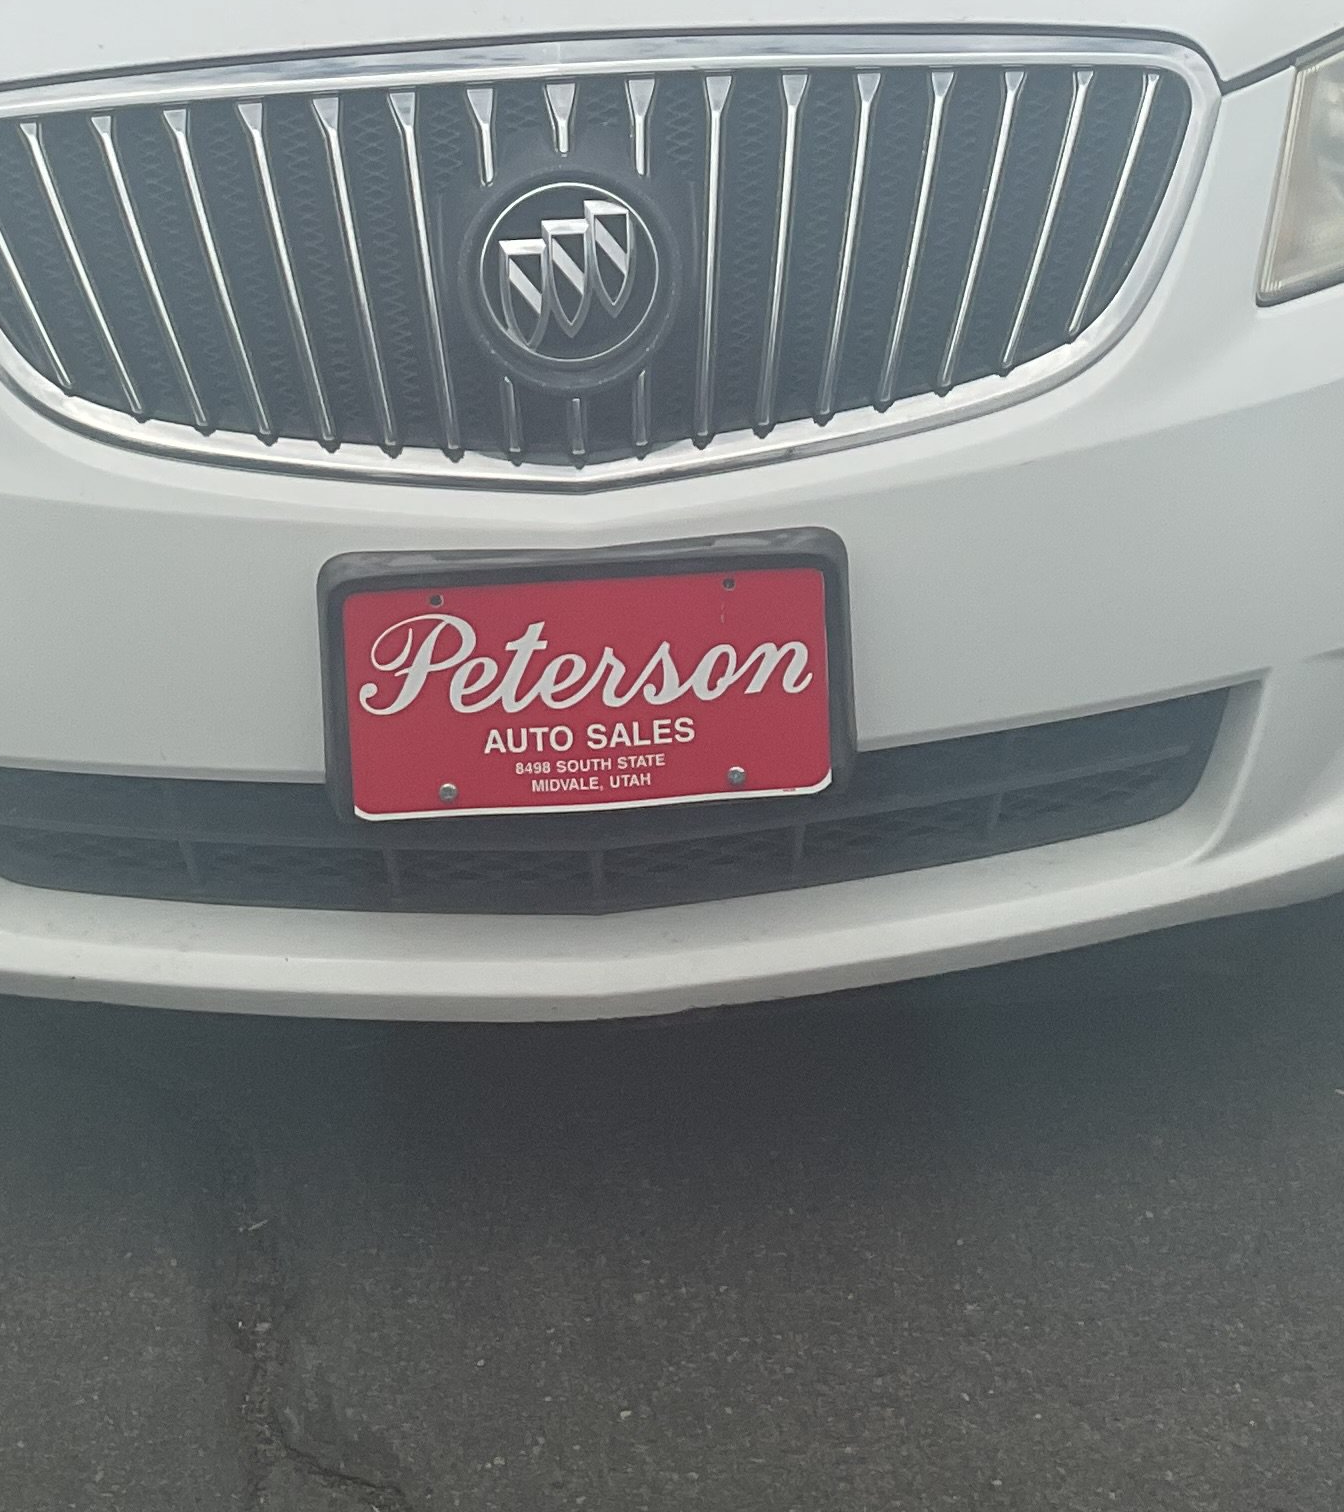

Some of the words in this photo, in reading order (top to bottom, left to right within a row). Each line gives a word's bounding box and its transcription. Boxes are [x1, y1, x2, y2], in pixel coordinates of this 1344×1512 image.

[359, 613, 814, 716] Peterson
[484, 725, 574, 754] AUTO
[587, 717, 696, 750] SALES
[515, 761, 551, 775] 8498
[556, 757, 612, 773] SOUTH
[617, 753, 666, 770] STATE
[531, 776, 604, 792] MIDVALE,
[609, 773, 652, 788] UTAH
